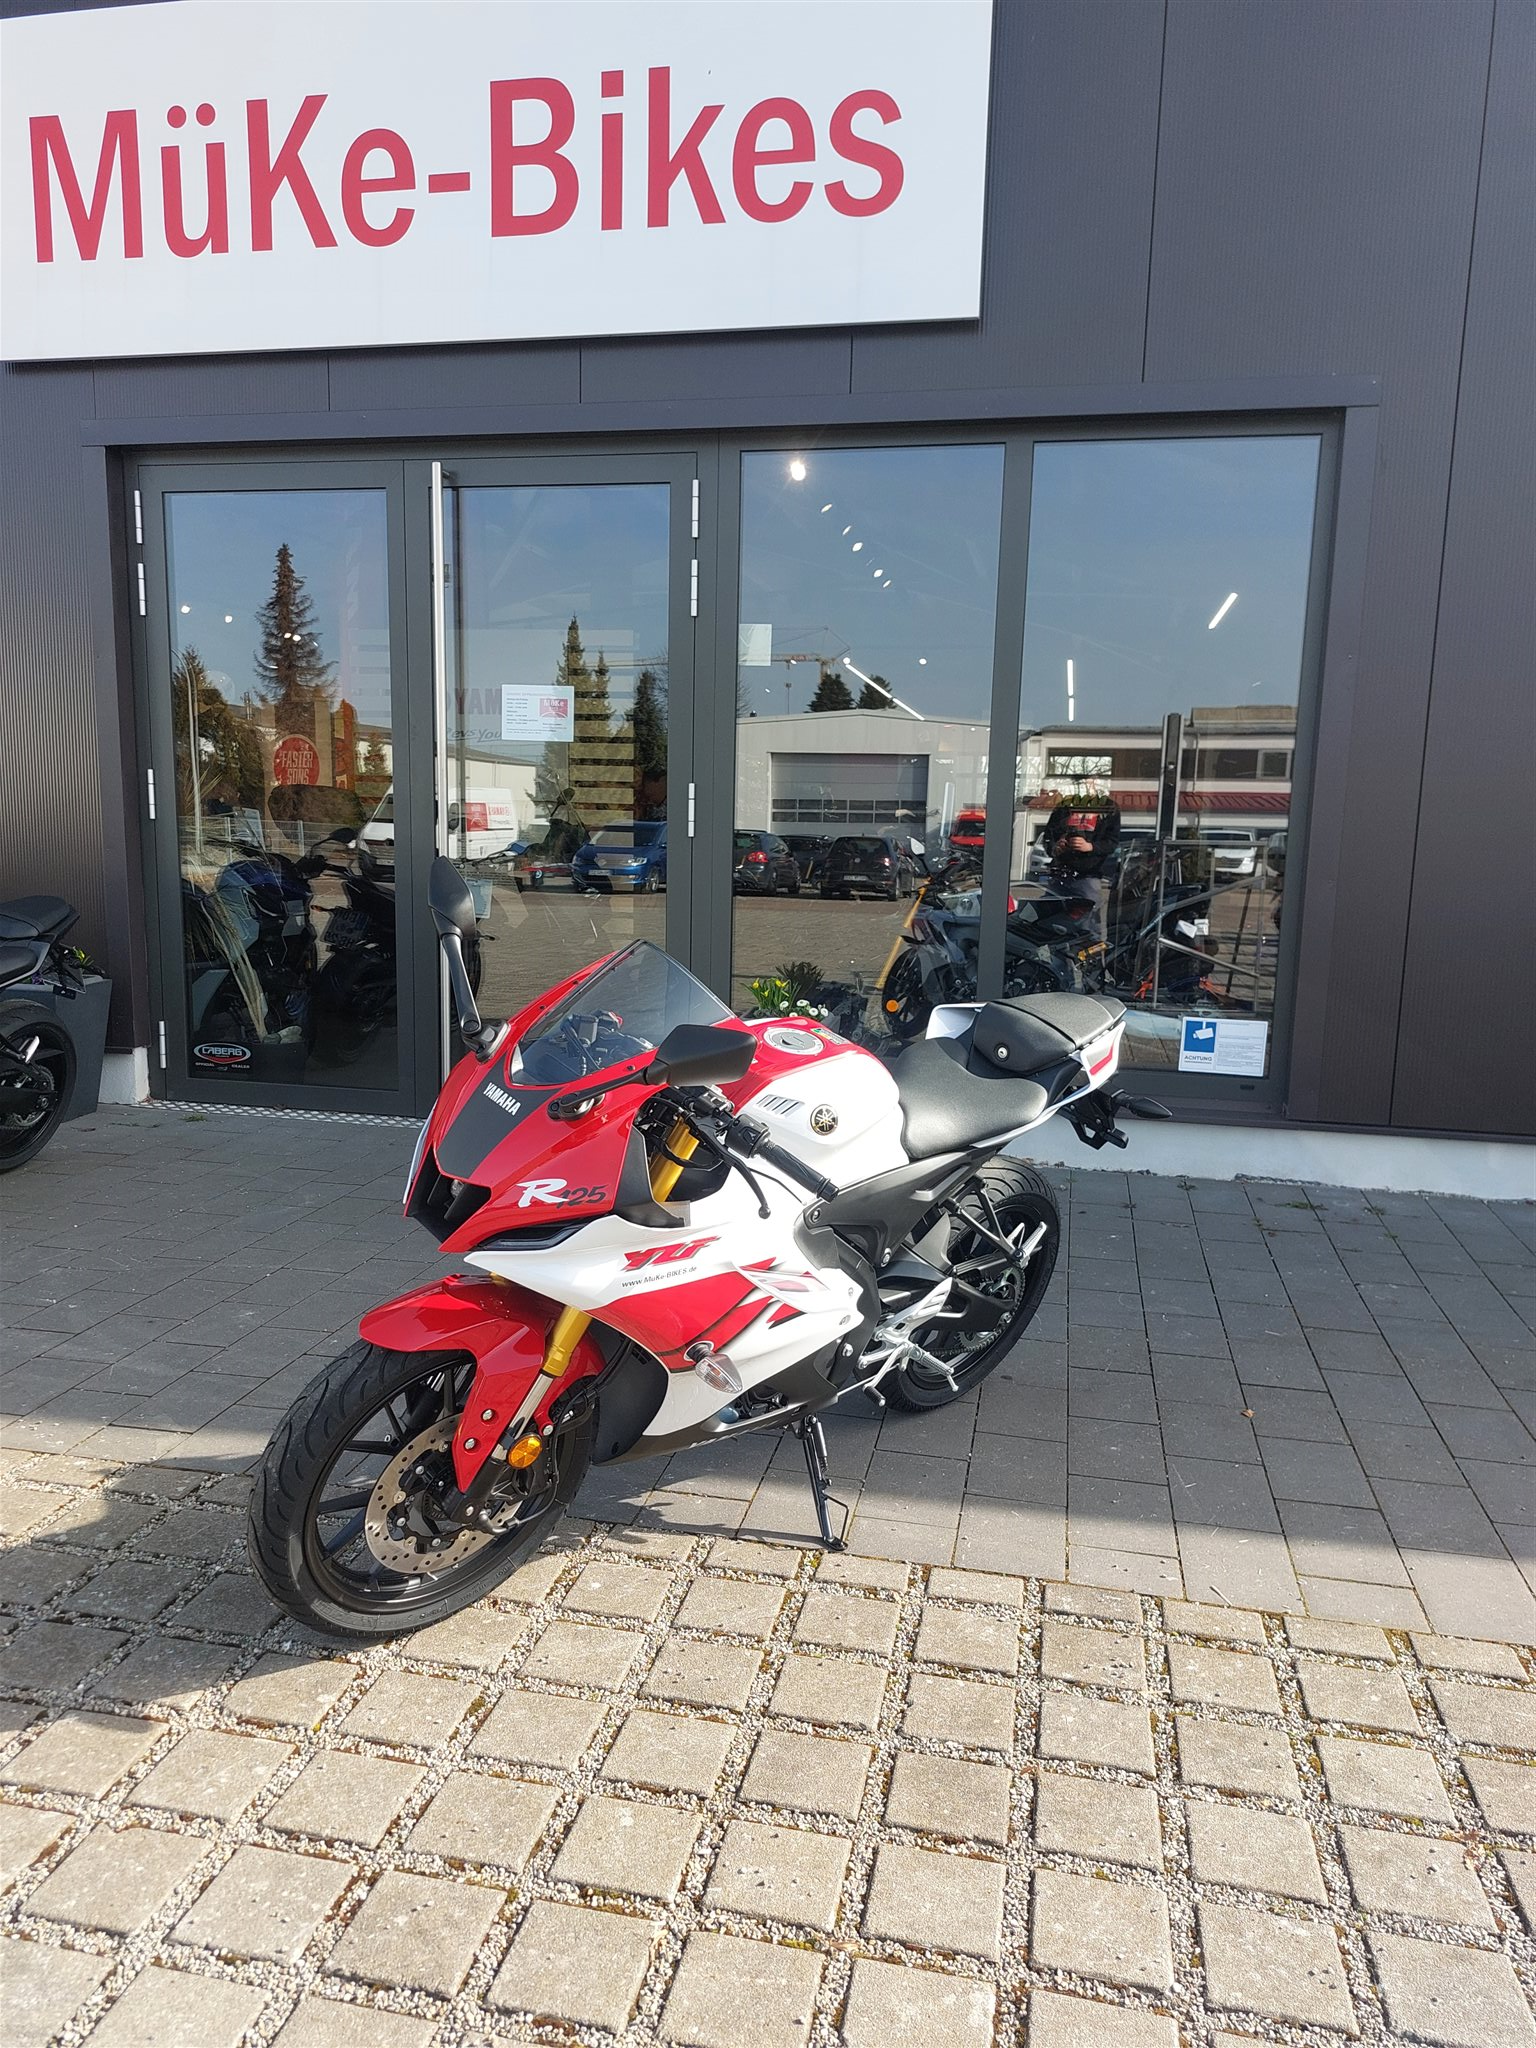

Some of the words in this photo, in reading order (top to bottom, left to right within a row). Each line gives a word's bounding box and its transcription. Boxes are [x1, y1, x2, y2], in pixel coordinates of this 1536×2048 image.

[29, 66, 905, 263] MüKe-Bikes
[282, 751, 313, 768] FASTER
[287, 769, 309, 785] SONS
[202, 1046, 242, 1056] CABERG
[483, 1082, 522, 1116] YAMAHA
[620, 1235, 722, 1272] YZF
